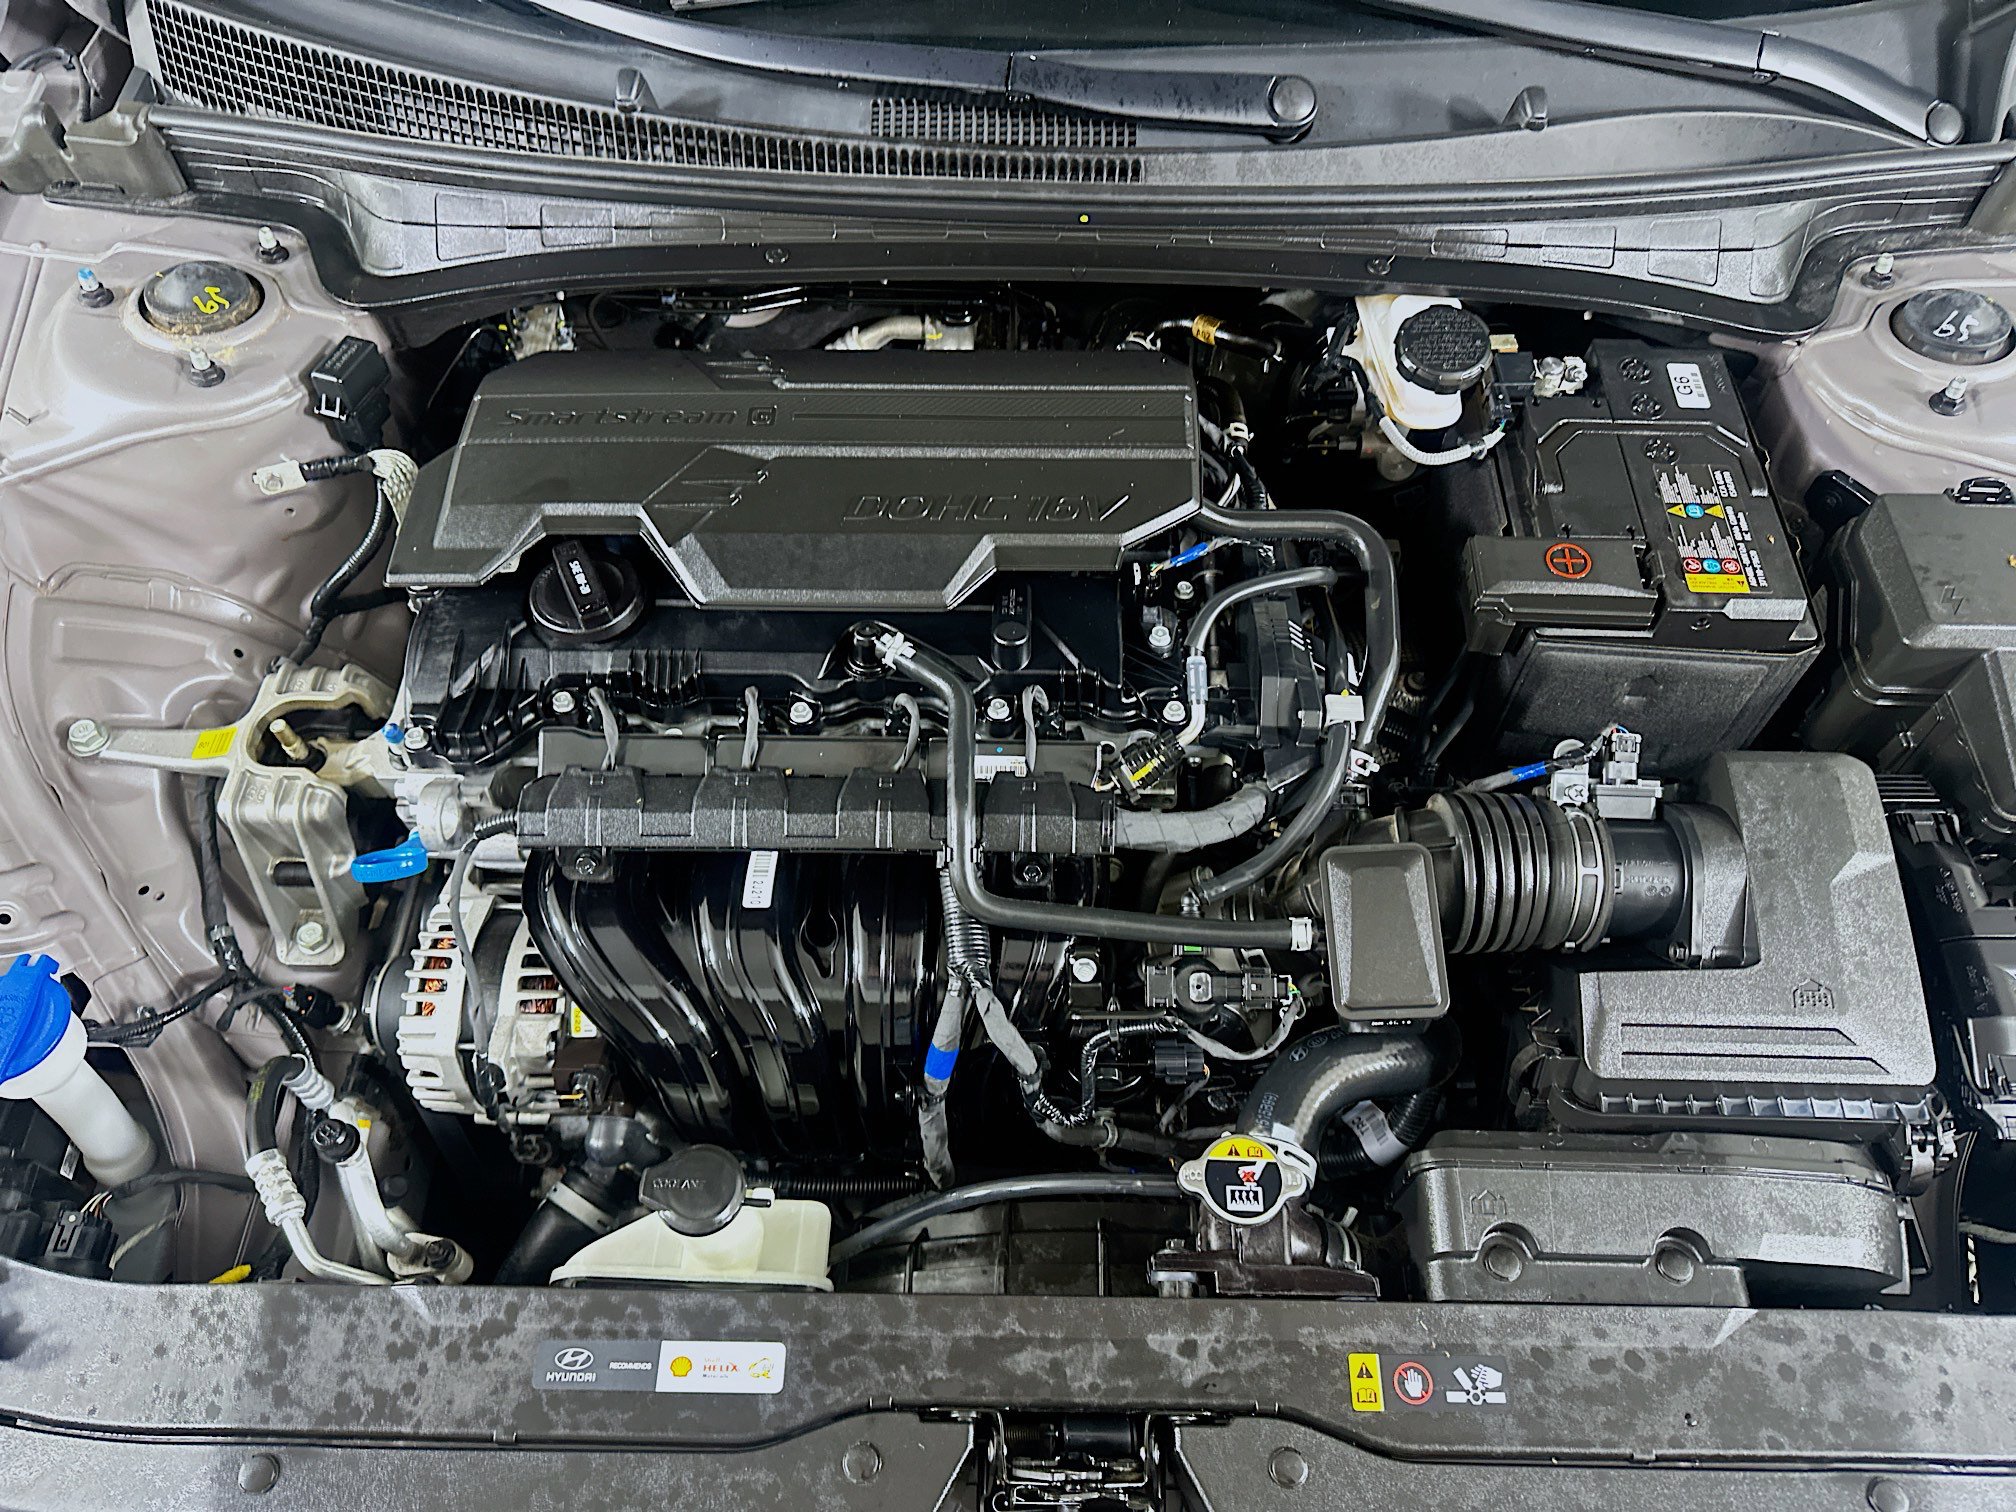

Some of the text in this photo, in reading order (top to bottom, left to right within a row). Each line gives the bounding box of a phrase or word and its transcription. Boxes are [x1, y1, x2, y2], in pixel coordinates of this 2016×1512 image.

[1932, 310, 1980, 342] 65
[1674, 375, 1693, 395] G6
[500, 407, 739, 425] Smartstream
[844, 495, 1130, 521] DOHC 16V
[1351, 1116, 1370, 1137] TRC
[609, 1361, 653, 1370] RECOMMENDS
[703, 1363, 739, 1372] HELIX
[546, 1372, 597, 1382] HYUNDAI
